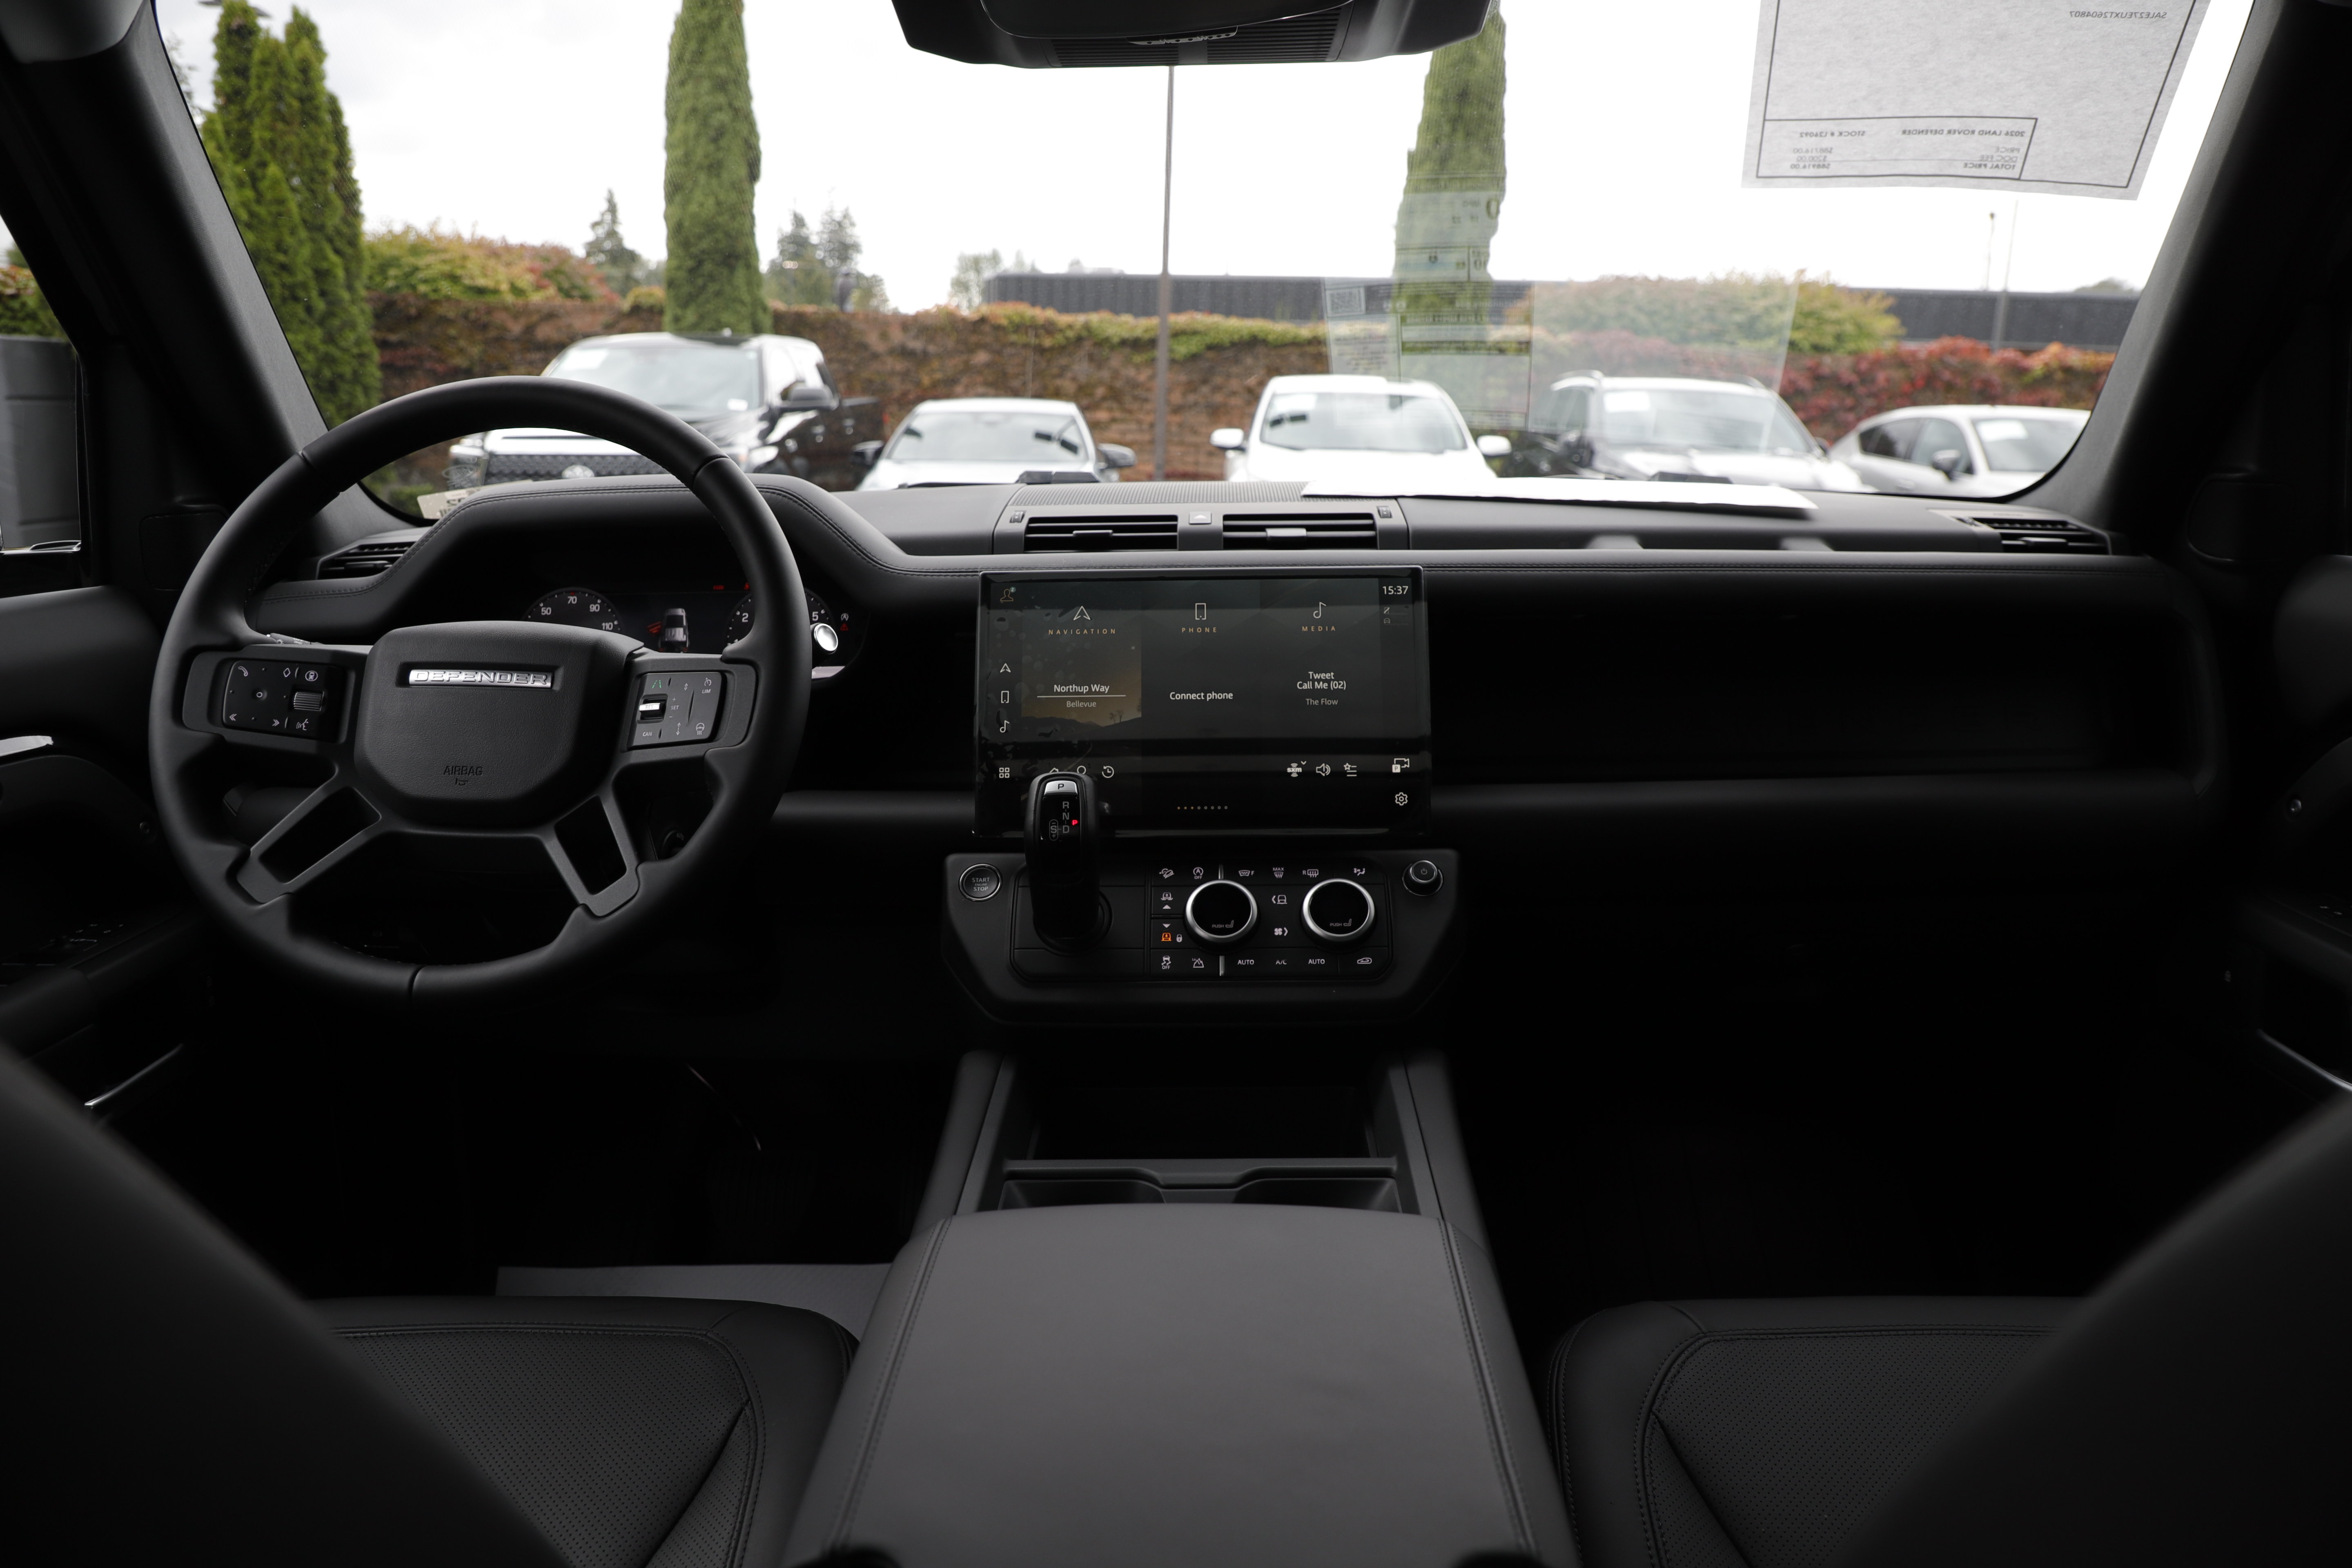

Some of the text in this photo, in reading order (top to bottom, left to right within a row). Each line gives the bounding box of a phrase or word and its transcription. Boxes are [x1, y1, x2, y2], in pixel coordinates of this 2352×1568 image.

[1382, 586, 1409, 595] 15:37
[567, 596, 577, 604] 70
[541, 607, 552, 615] 50
[589, 604, 600, 612] 90
[742, 612, 749, 623] 2
[812, 611, 819, 621] 5
[601, 622, 613, 630] 110
[414, 671, 547, 684] DEFENDER
[1308, 671, 1335, 679] Tweet
[1054, 684, 1110, 694] Northup Way
[1296, 681, 1312, 689] Call
[1330, 680, 1347, 690] (02)
[1169, 691, 1234, 702] Connect phone
[443, 766, 483, 775] AIRBAG
[1050, 825, 1057, 833] S
[1062, 825, 1070, 833] D
